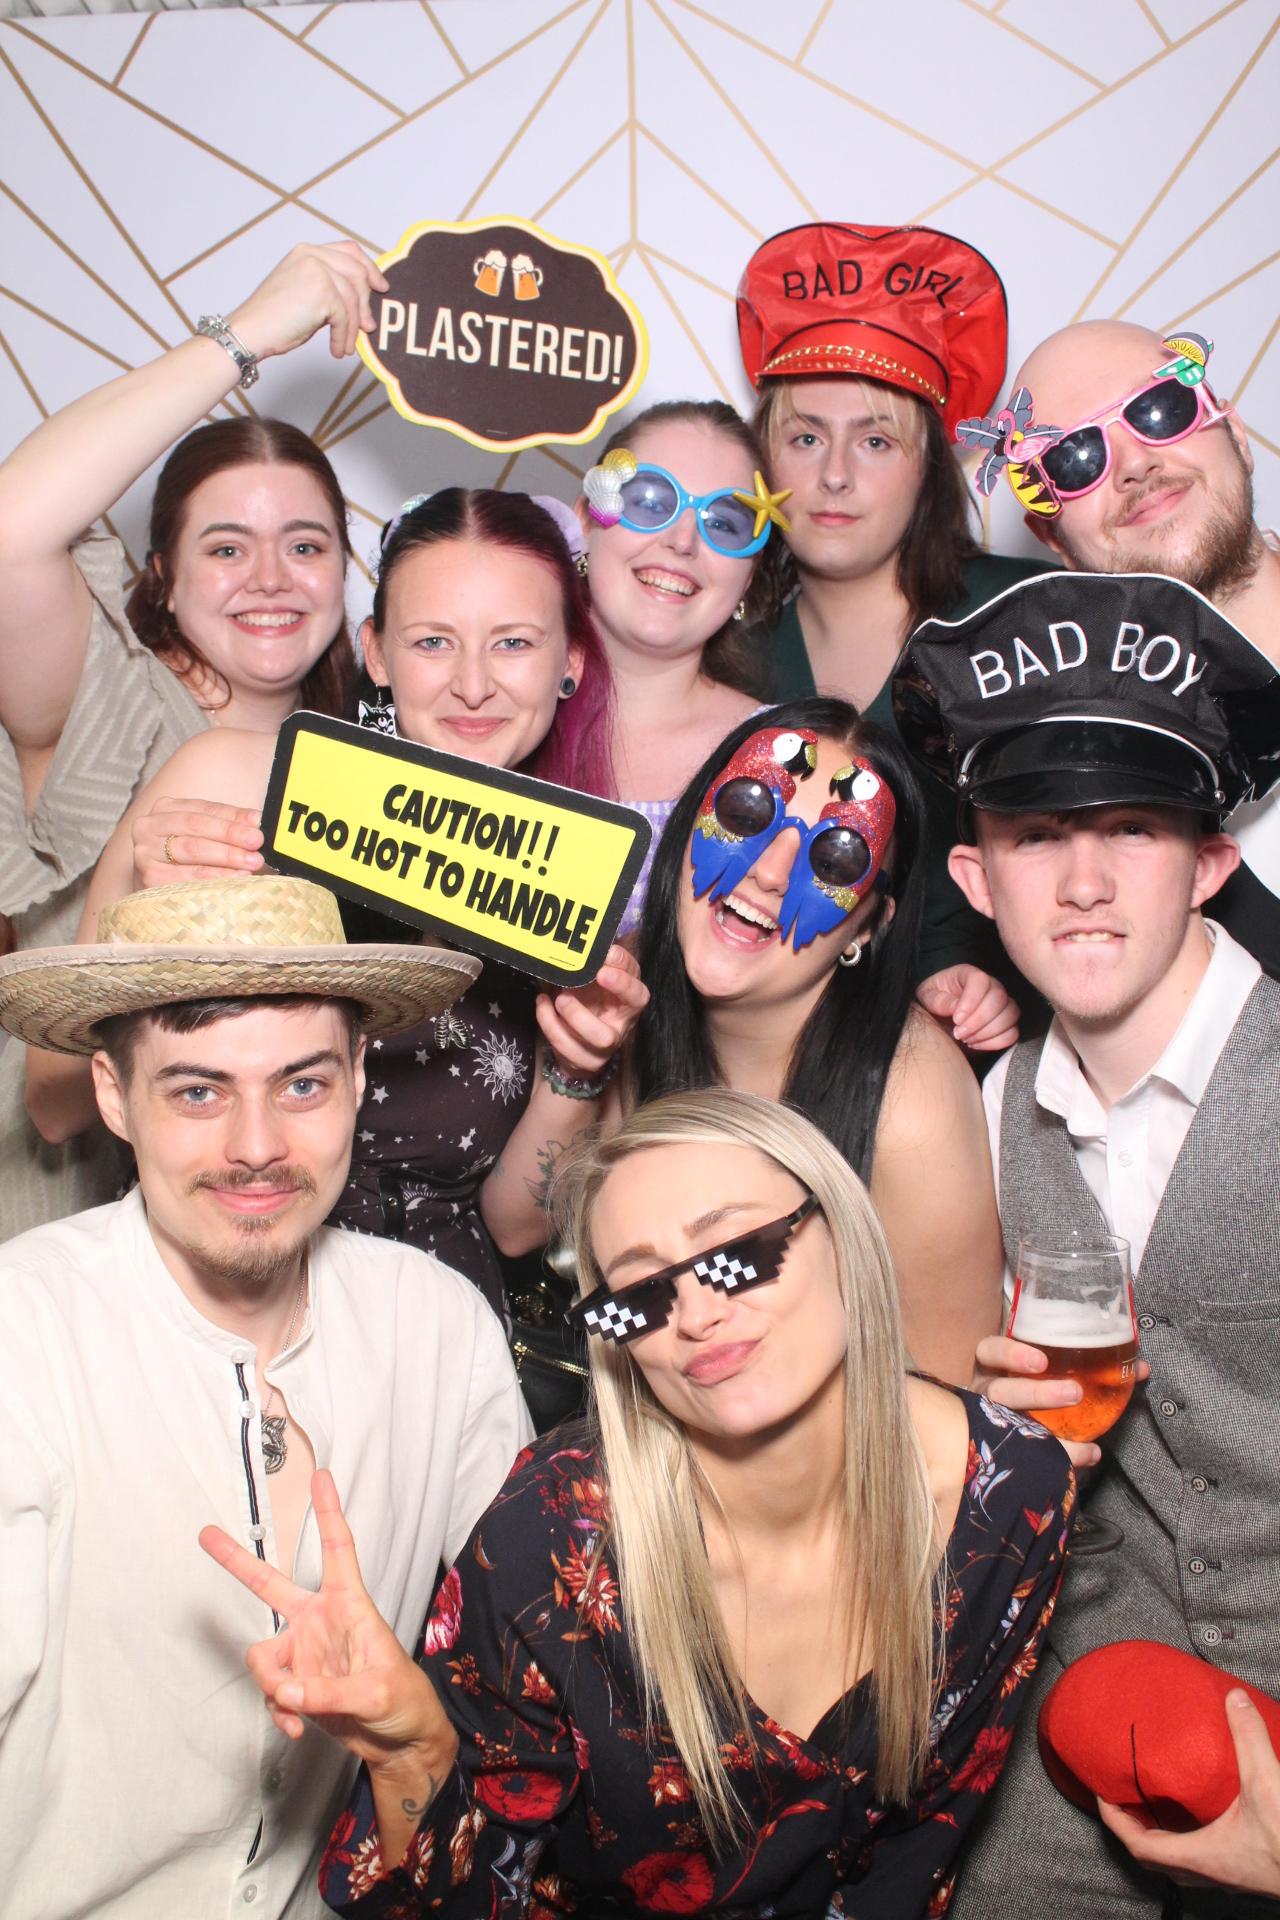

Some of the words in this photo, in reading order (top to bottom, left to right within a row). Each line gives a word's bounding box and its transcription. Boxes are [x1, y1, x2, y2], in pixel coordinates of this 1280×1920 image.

[783, 259, 863, 300] BAD
[884, 262, 964, 308] GIRL
[378, 298, 624, 385] PLASTERED!
[969, 621, 1088, 699] BAD
[1111, 621, 1208, 697] BOY
[382, 784, 560, 877] CAUTION!!
[287, 800, 349, 851] TOO
[351, 826, 421, 880] HOT
[423, 851, 464, 898] TO
[465, 868, 598, 954] HANDLE
